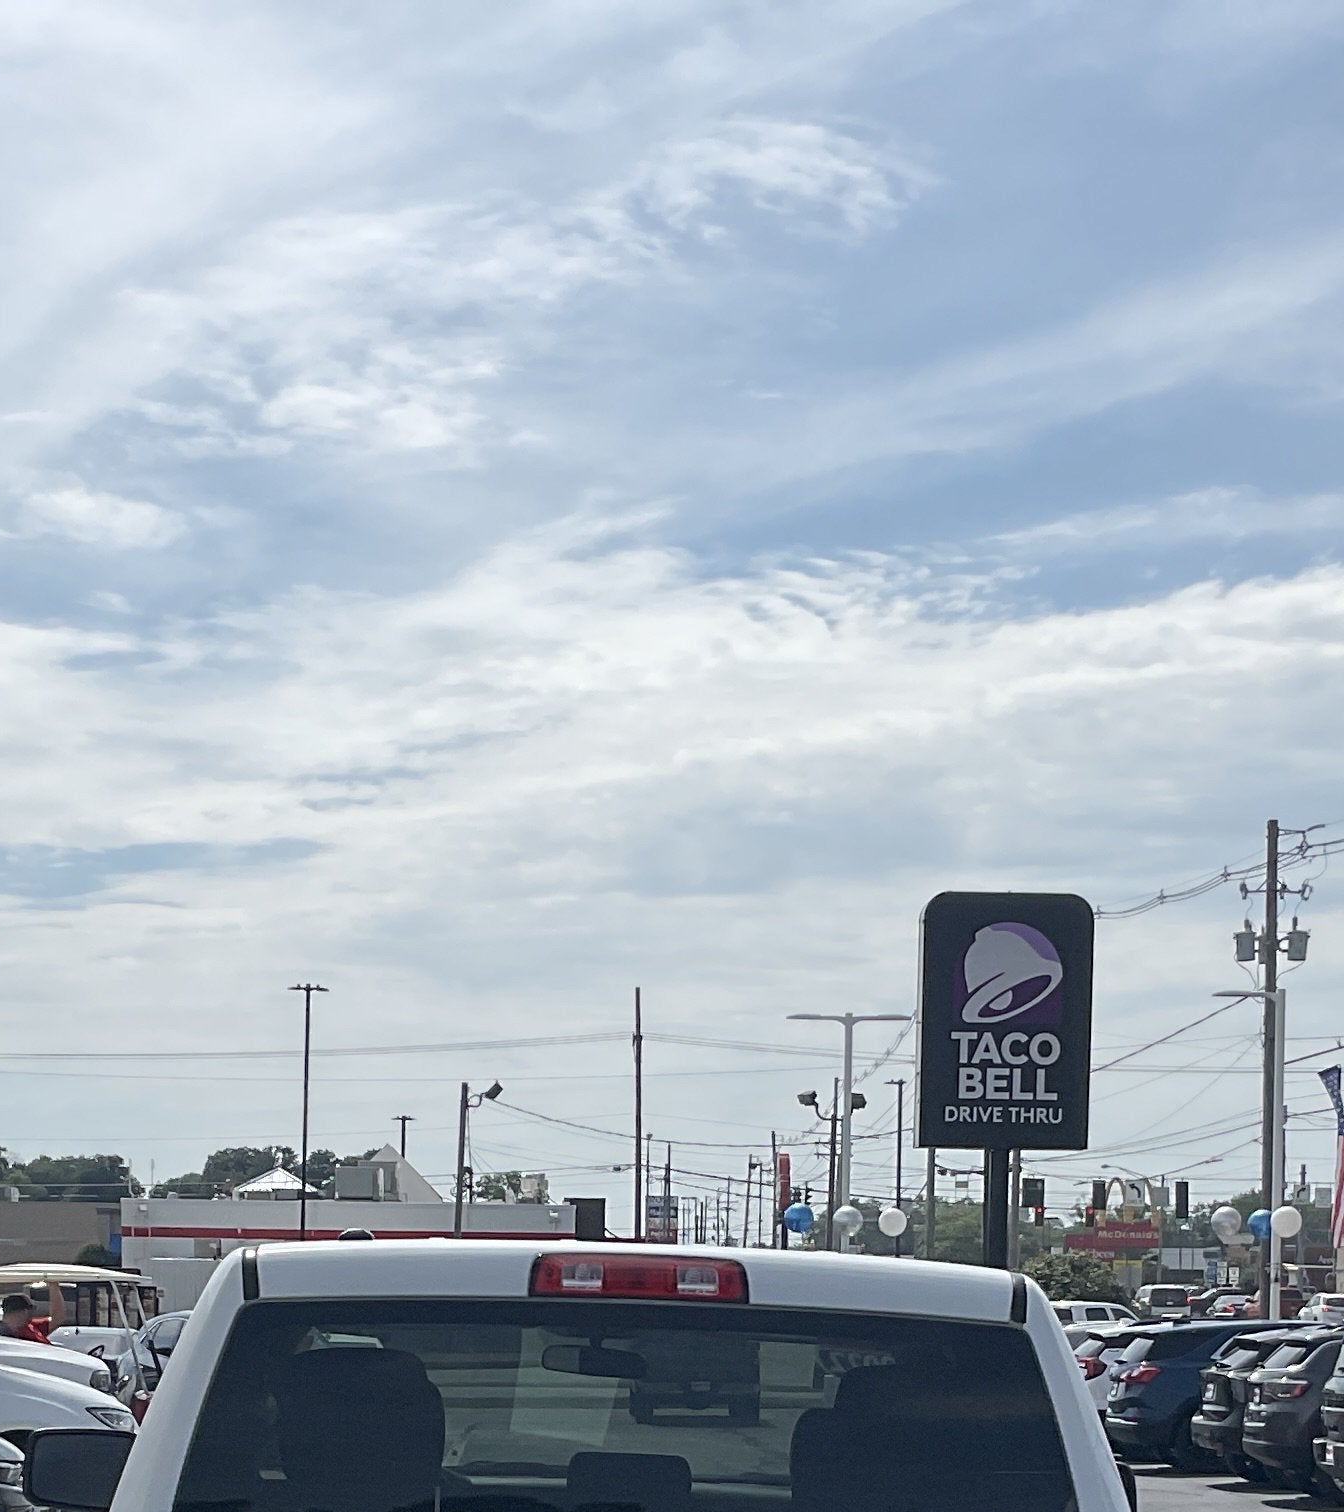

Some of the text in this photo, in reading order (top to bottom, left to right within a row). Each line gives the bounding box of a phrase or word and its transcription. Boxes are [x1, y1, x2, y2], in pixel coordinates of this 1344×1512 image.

[950, 1031, 1062, 1066] TACO
[957, 1067, 1058, 1101] BELL
[944, 1105, 1063, 1125] DRIVE THRU
